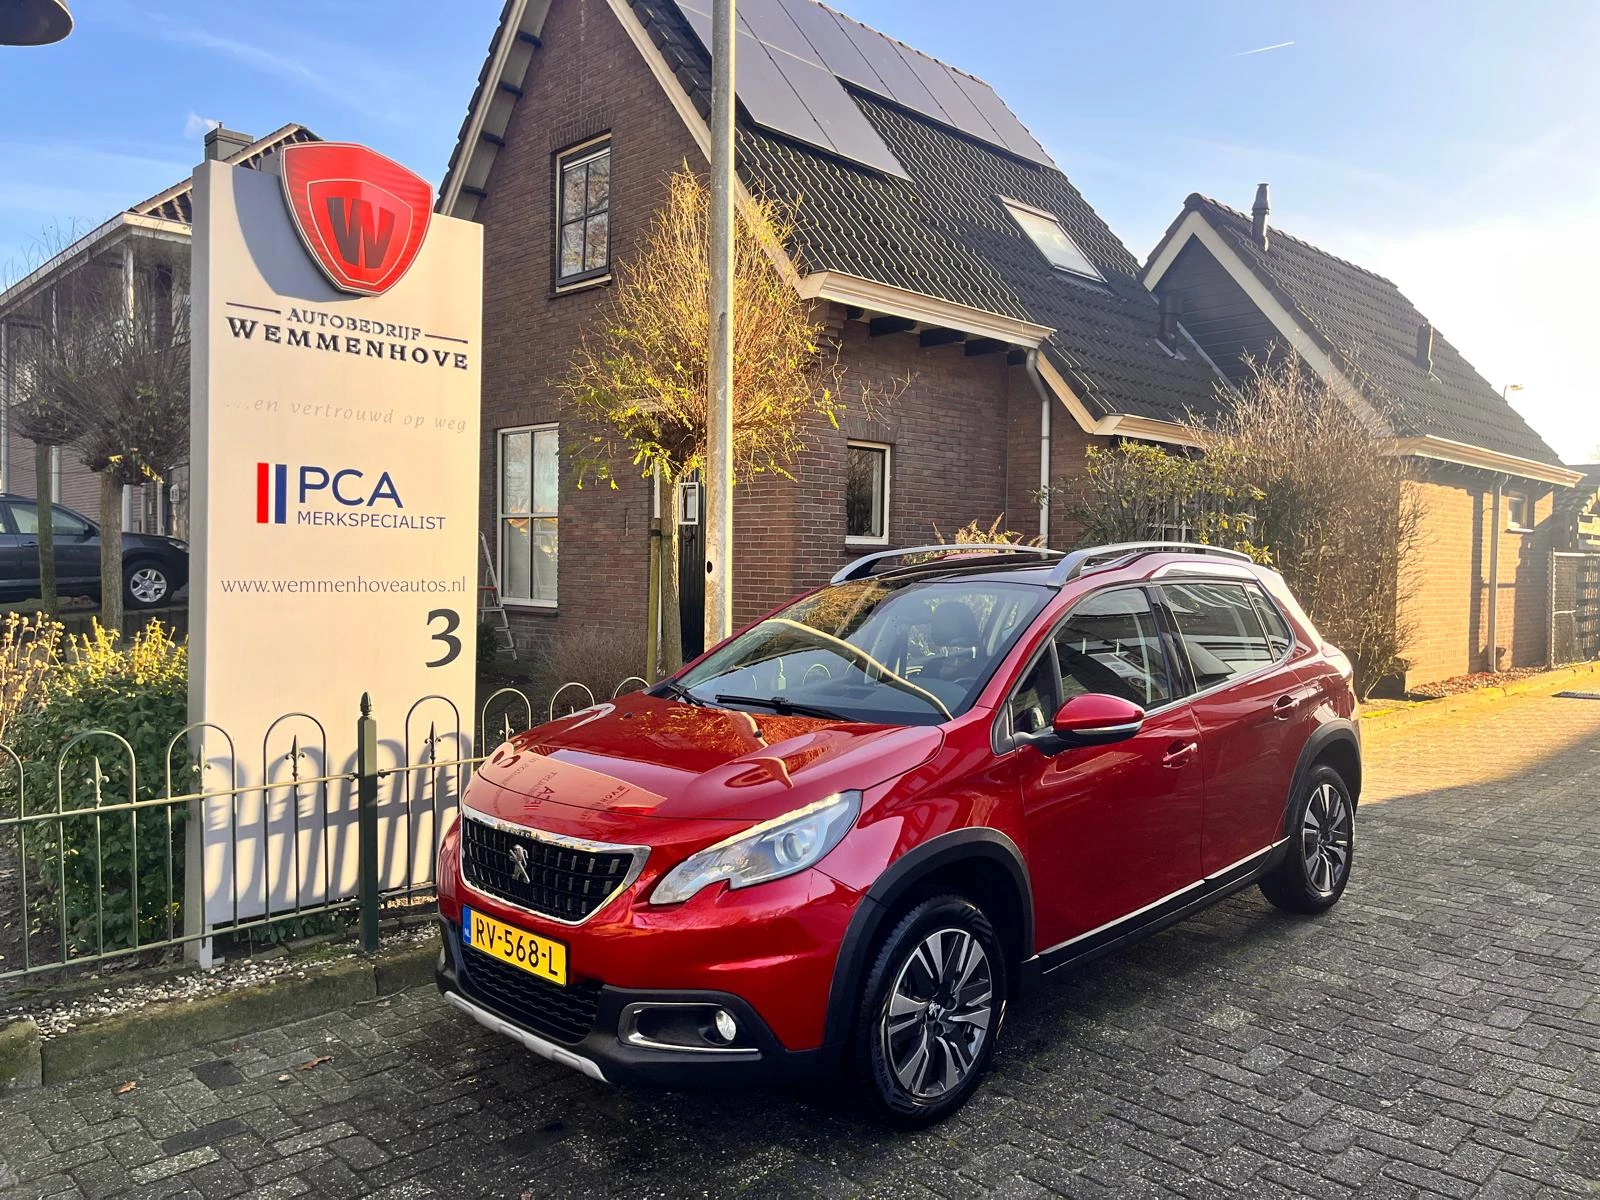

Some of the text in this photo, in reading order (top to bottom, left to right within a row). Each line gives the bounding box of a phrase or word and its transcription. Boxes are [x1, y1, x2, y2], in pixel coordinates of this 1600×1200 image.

[326, 197, 395, 269] W
[225, 316, 469, 370] WEMMENHOVE
[287, 308, 421, 341] AUTOBEDRIJF
[291, 402, 394, 424] vertrouwd
[403, 414, 425, 429] op
[434, 416, 467, 434] weg
[299, 466, 404, 509] PCA
[297, 511, 446, 530] MERKSPECIALIST
[220, 576, 466, 593] www.wemmenhoveautos.nl
[425, 608, 462, 668] 3
[476, 917, 559, 976] RV-568-L
